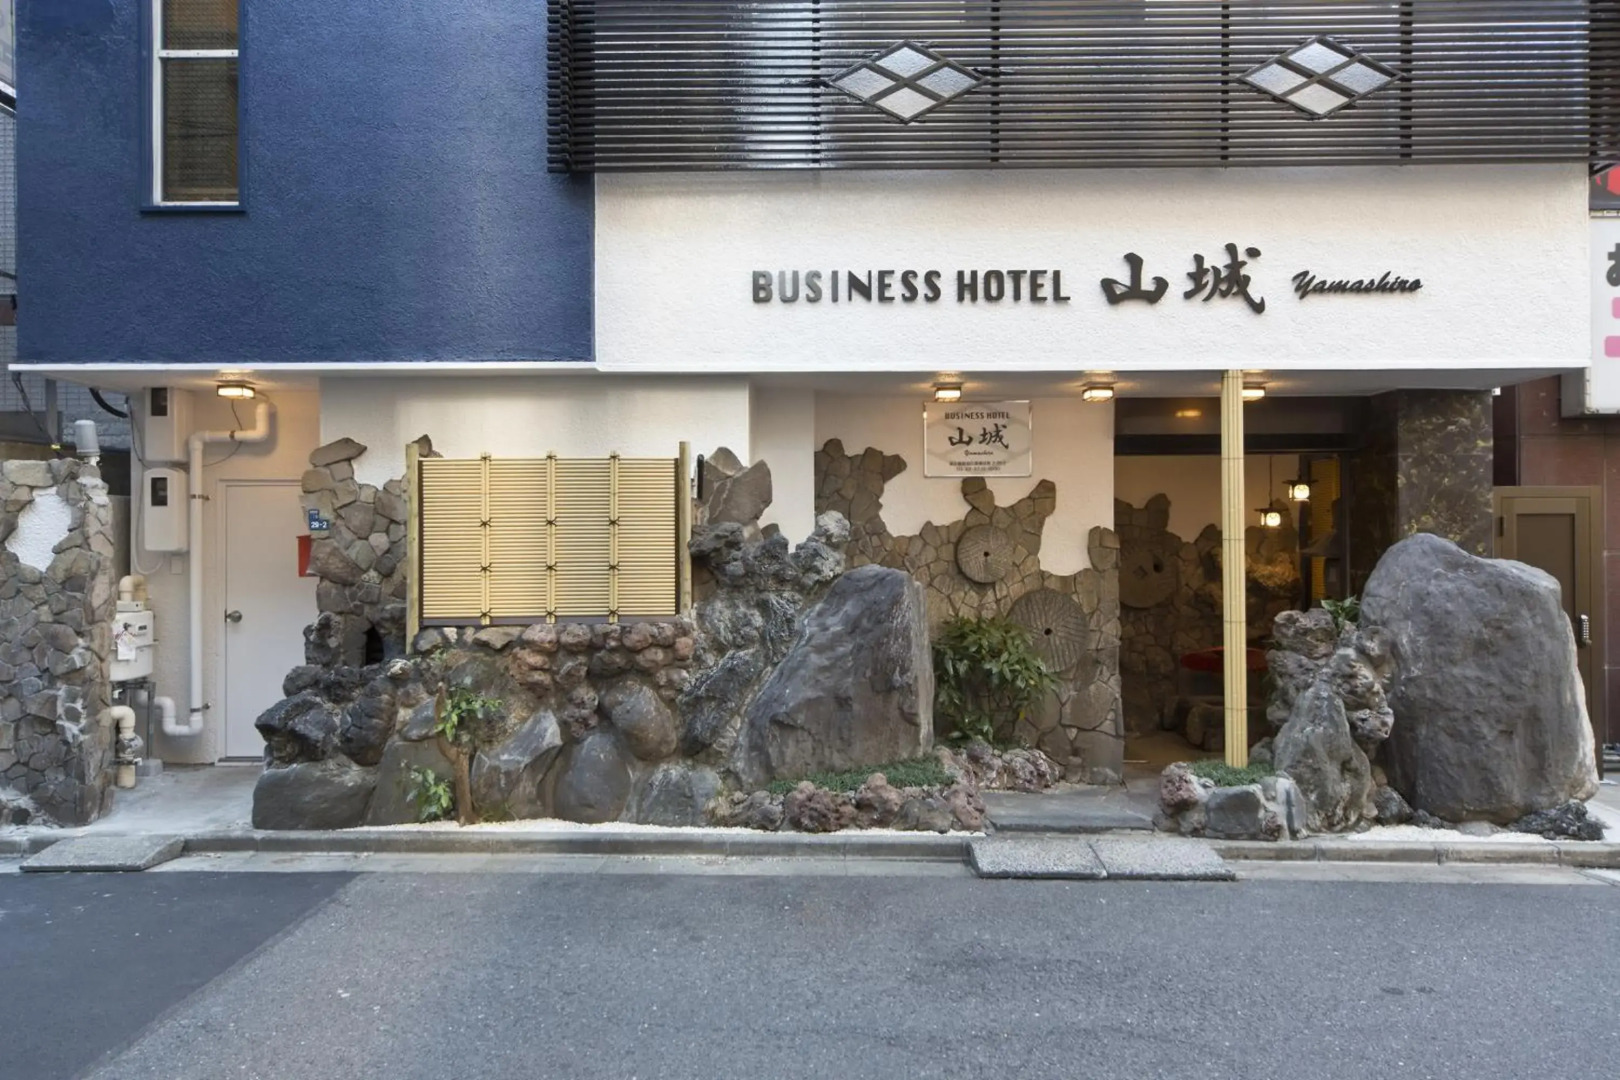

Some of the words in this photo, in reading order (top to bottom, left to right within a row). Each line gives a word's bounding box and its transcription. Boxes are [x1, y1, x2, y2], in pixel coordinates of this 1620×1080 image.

[752, 269, 942, 304] BUSINESS
[956, 269, 1071, 304] HOTEL
[1100, 242, 1266, 315] 山城
[1291, 270, 1423, 301] Yamashiro
[944, 412, 985, 420] BUSINESS
[986, 412, 1011, 420] HOTEL
[948, 423, 1009, 449] 山城
